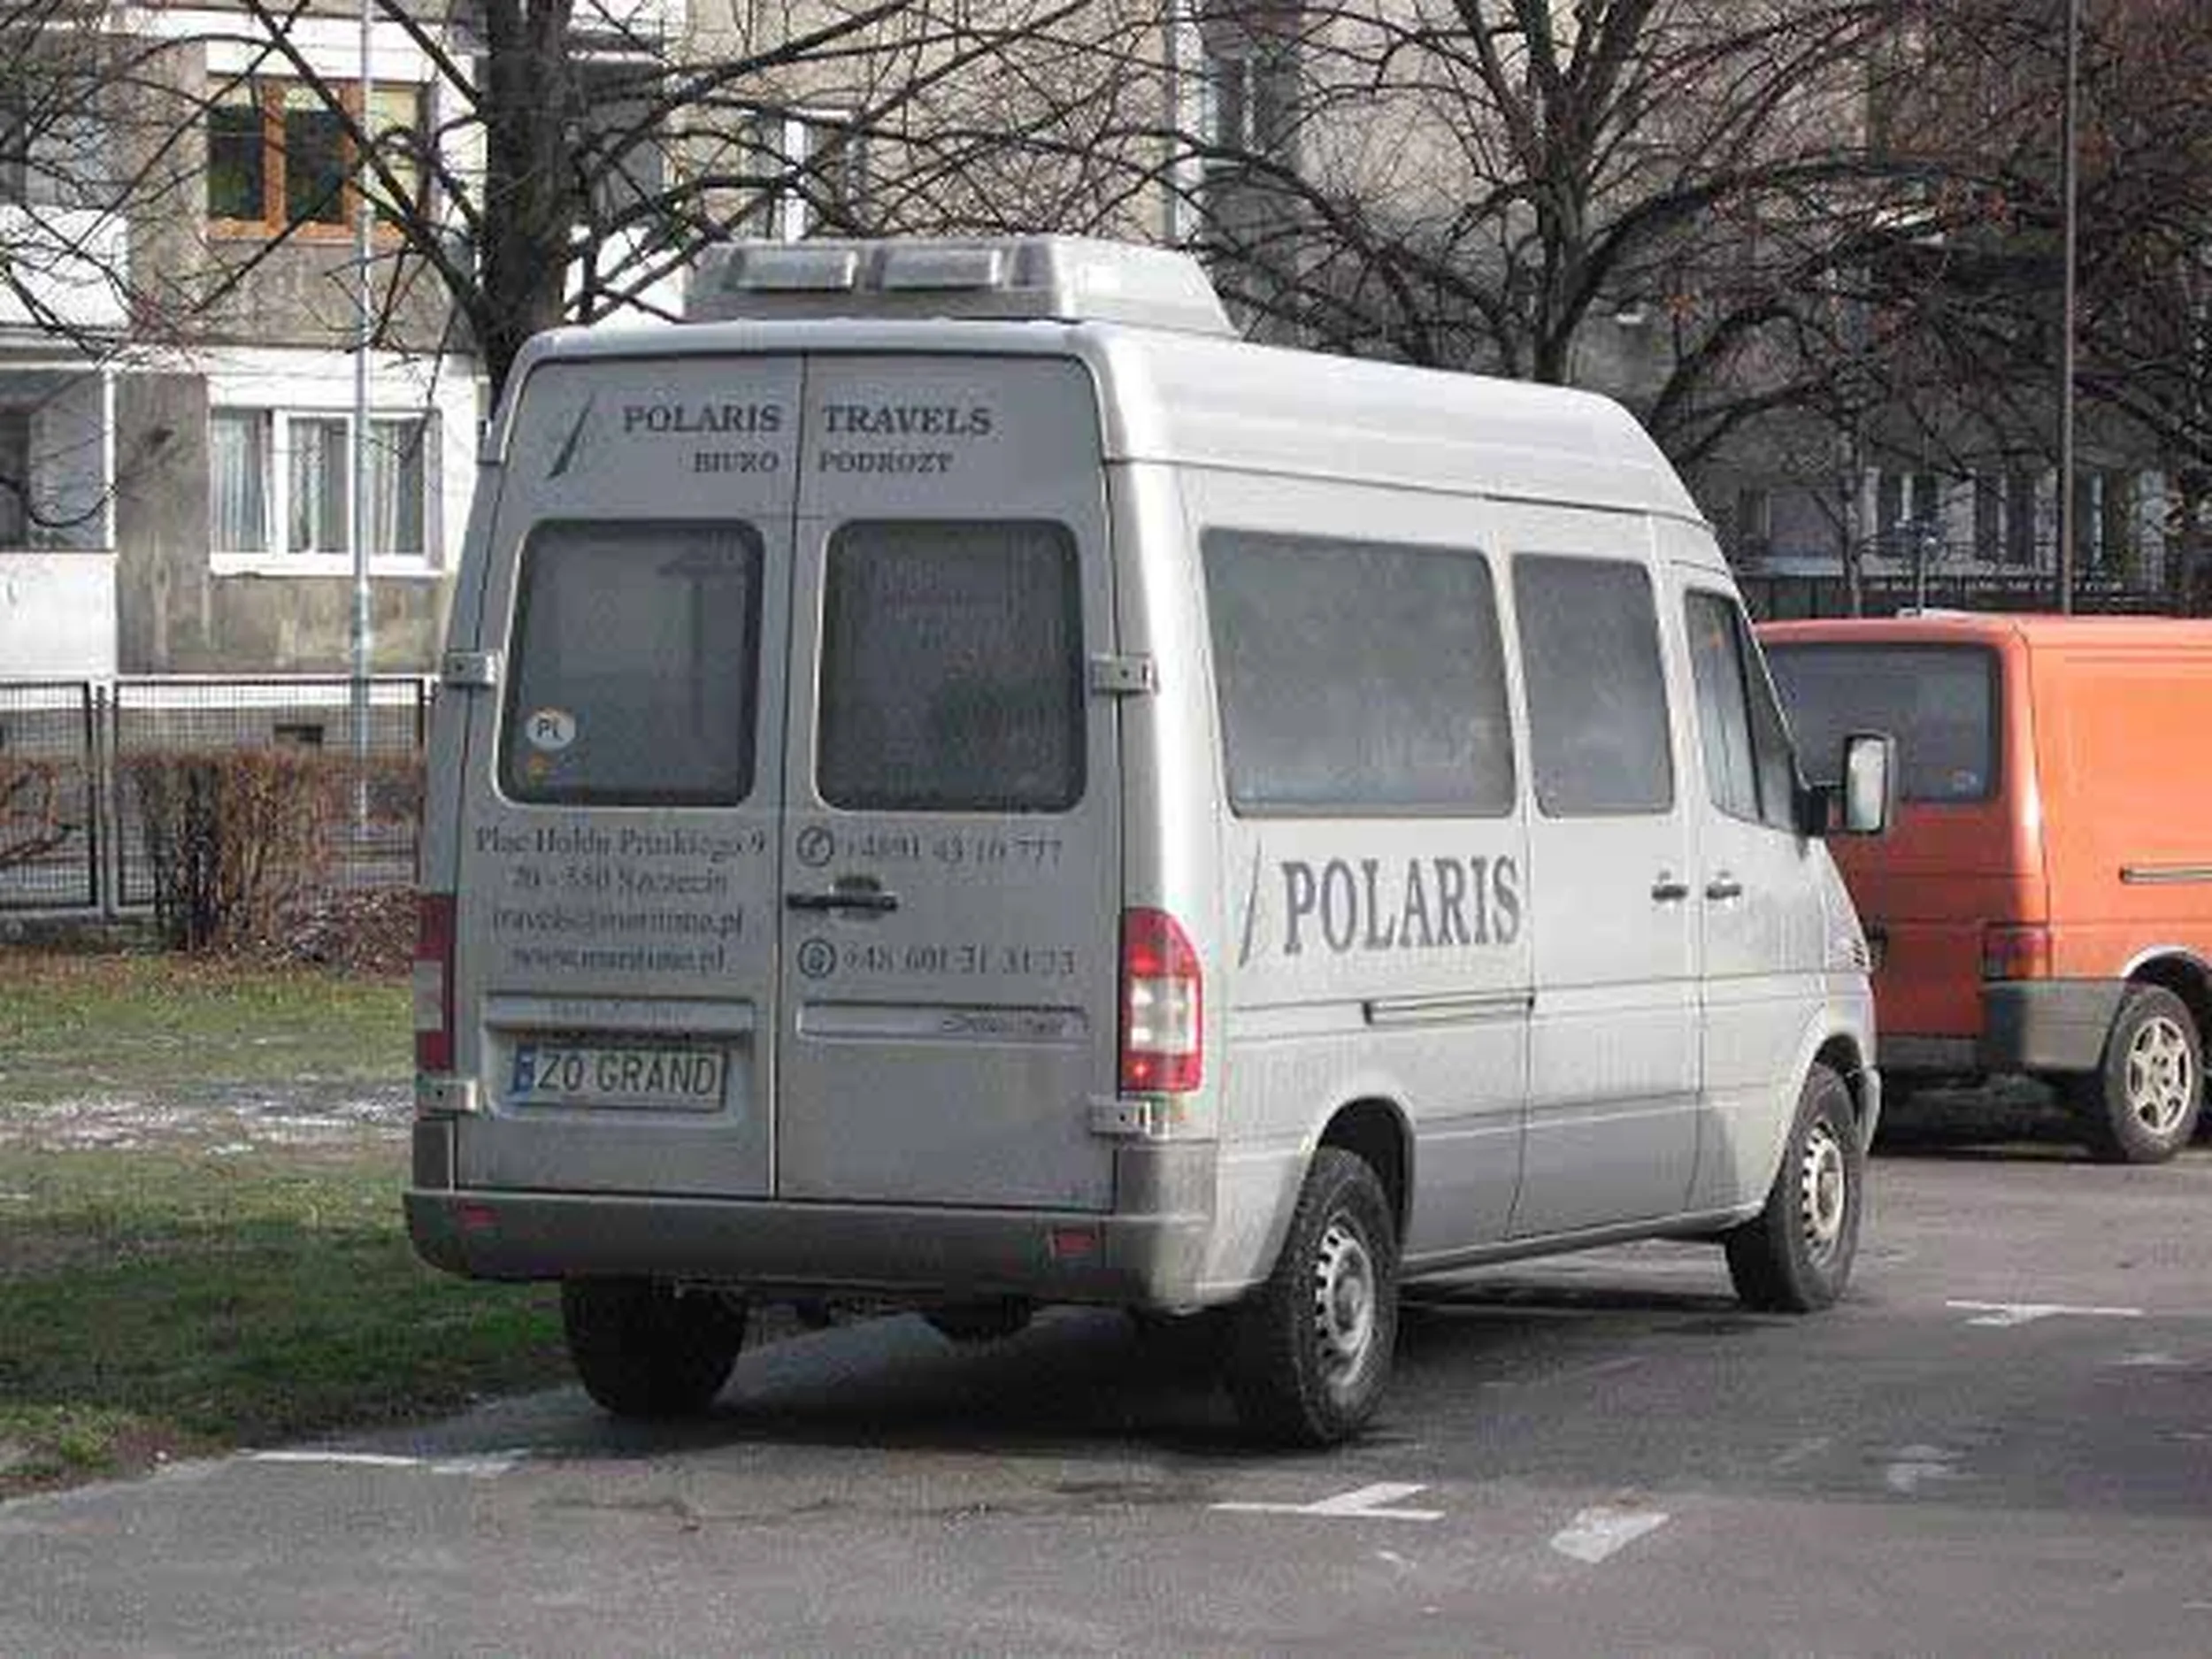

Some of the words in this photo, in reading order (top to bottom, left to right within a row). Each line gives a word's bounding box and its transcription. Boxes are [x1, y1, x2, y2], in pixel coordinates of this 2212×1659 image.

[622, 404, 781, 434] POLARIS
[820, 404, 993, 436] TRAVELS
[1279, 855, 1522, 956] POLARIS
[595, 1053, 718, 1096] GRAND
